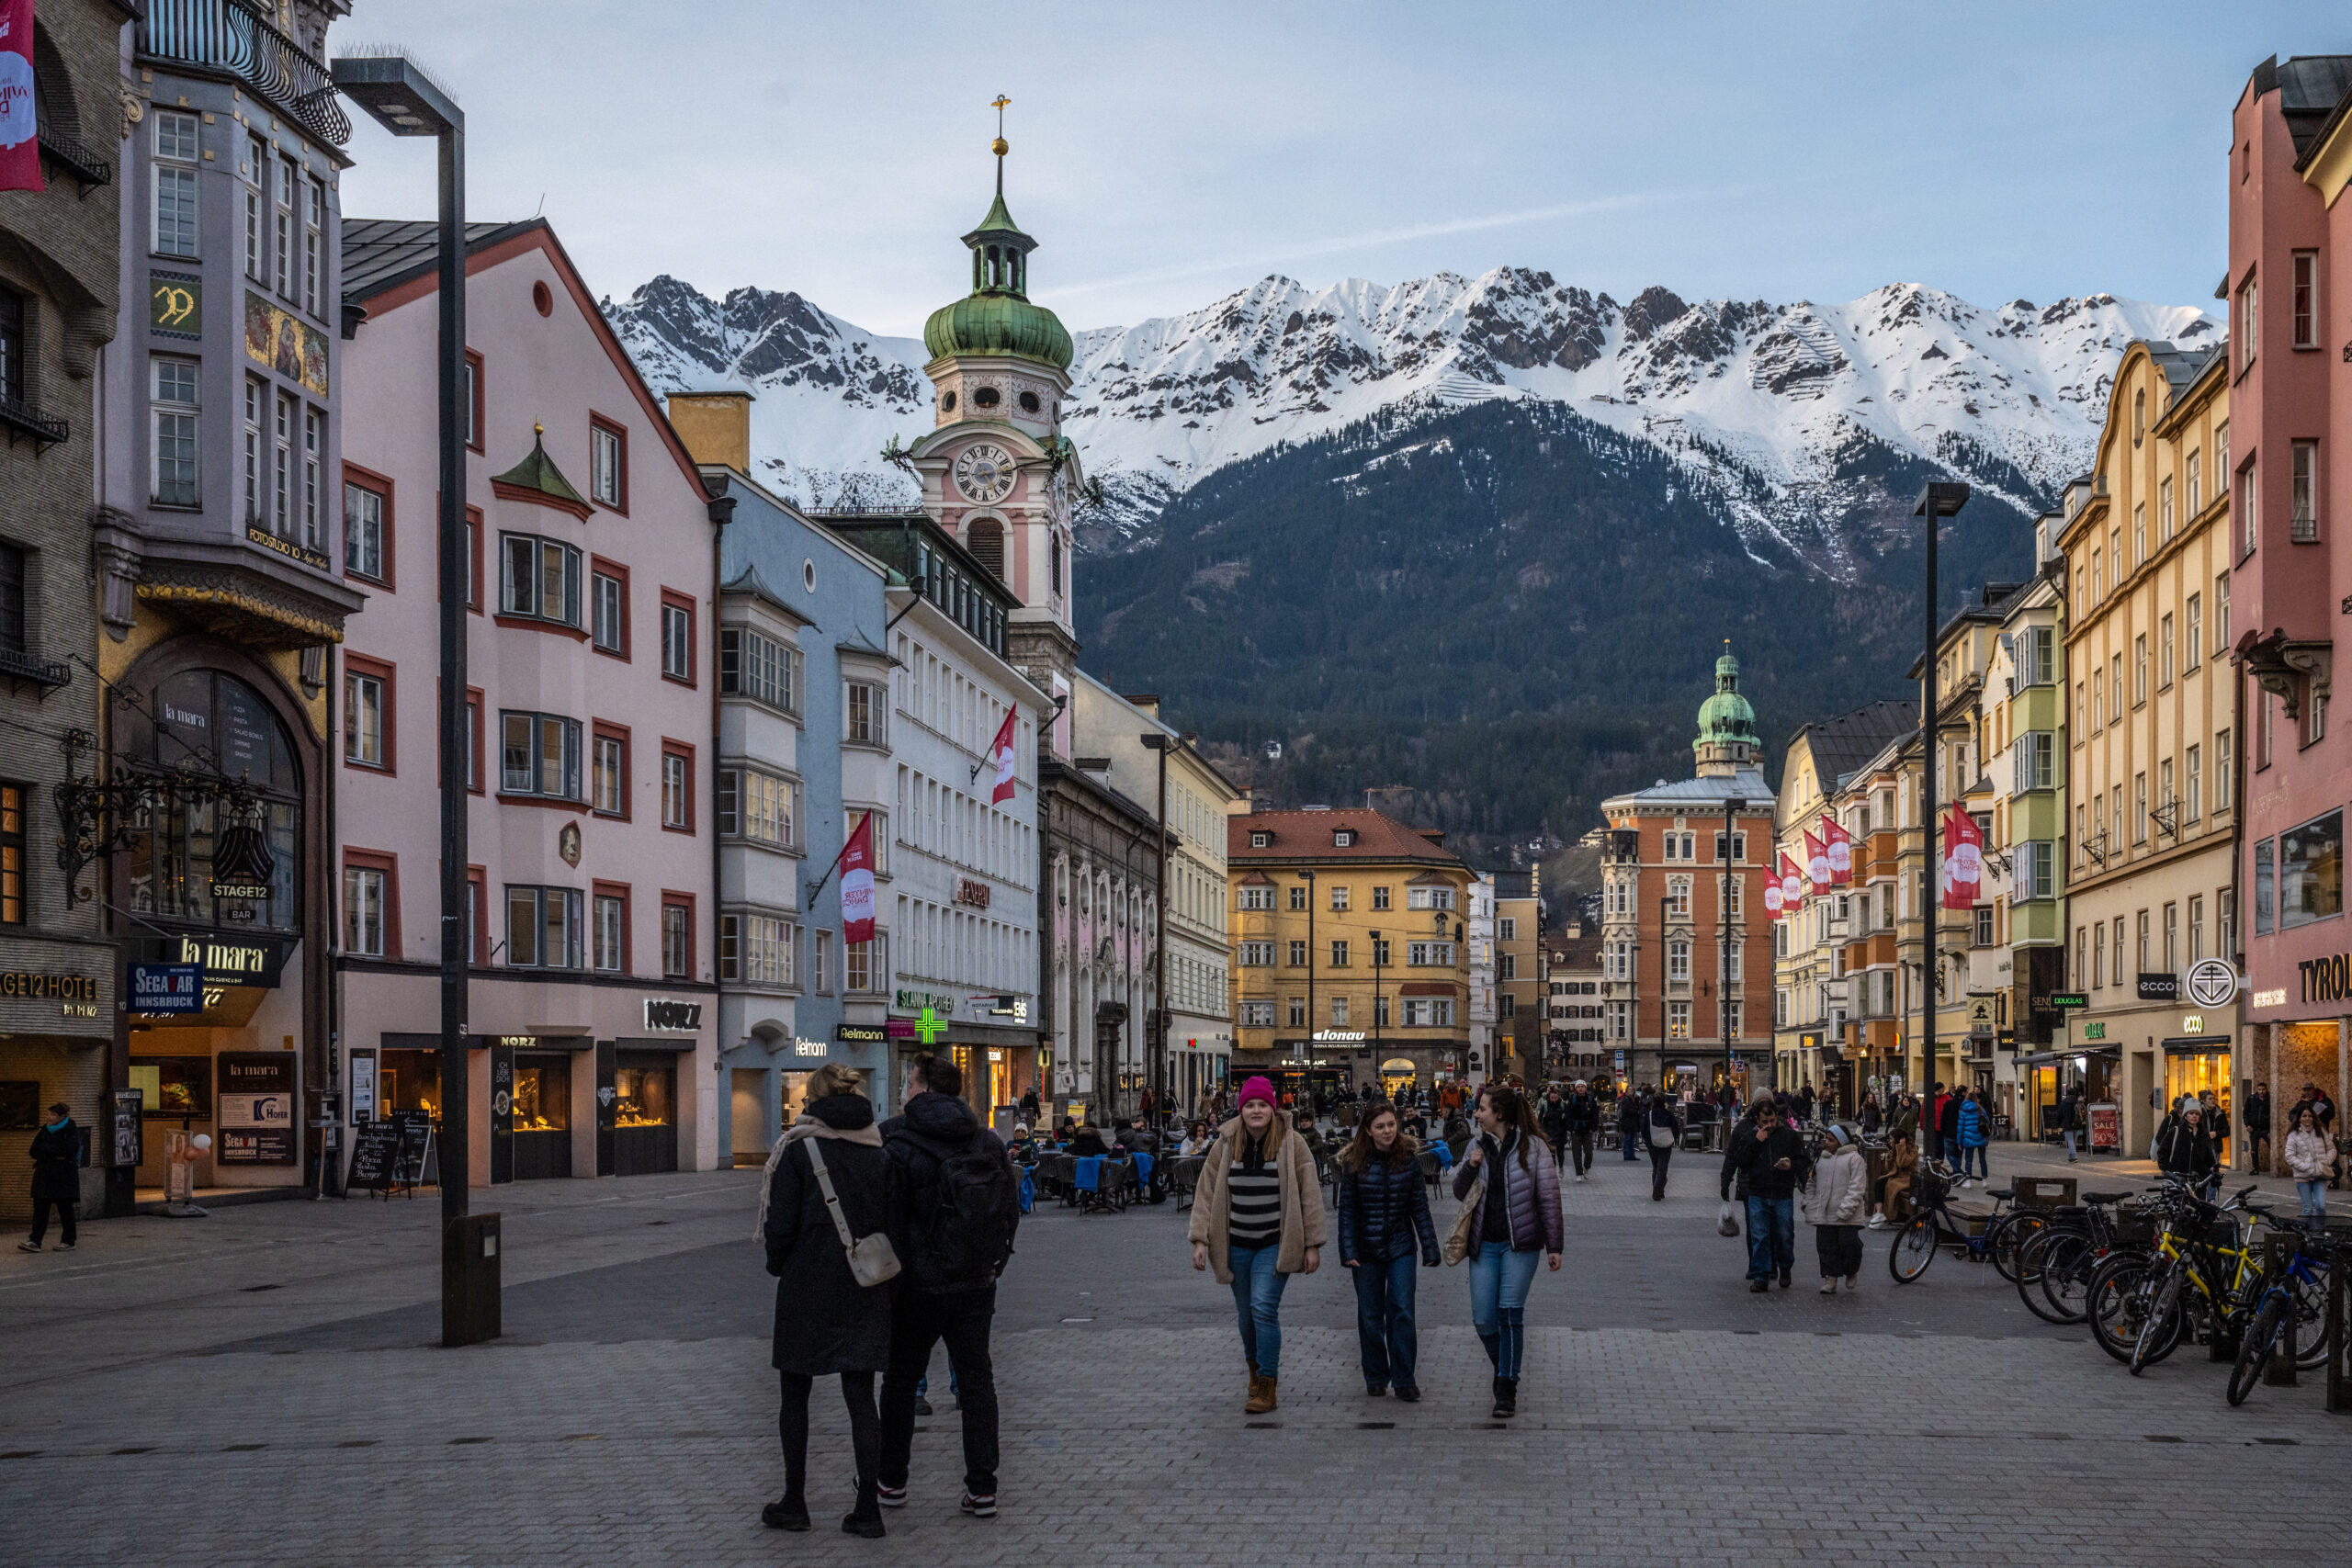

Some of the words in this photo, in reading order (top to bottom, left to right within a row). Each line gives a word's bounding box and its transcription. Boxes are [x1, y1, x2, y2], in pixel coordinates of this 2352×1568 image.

[249, 528, 290, 555] FOTOSTUDIO
[292, 546, 300, 559] 10
[165, 703, 175, 720] la
[177, 709, 205, 728] mara
[213, 885, 267, 898] STAGE12
[232, 909, 251, 919] BAR
[181, 933, 200, 963] la
[205, 944, 265, 972] mara
[0, 973, 43, 996] GE12
[49, 976, 101, 999] HOTEL
[2140, 982, 2175, 991] ecco
[135, 997, 194, 1008] INNSBRUCK
[647, 1000, 702, 1030] NORZ
[2184, 1015, 2203, 1033] ecco
[841, 1027, 883, 1041] fielmann
[501, 1036, 537, 1047] NORZ
[795, 1036, 827, 1056] fielmann
[230, 1064, 241, 1076] la
[244, 1066, 279, 1076] mara
[266, 1108, 288, 1119] HOFER
